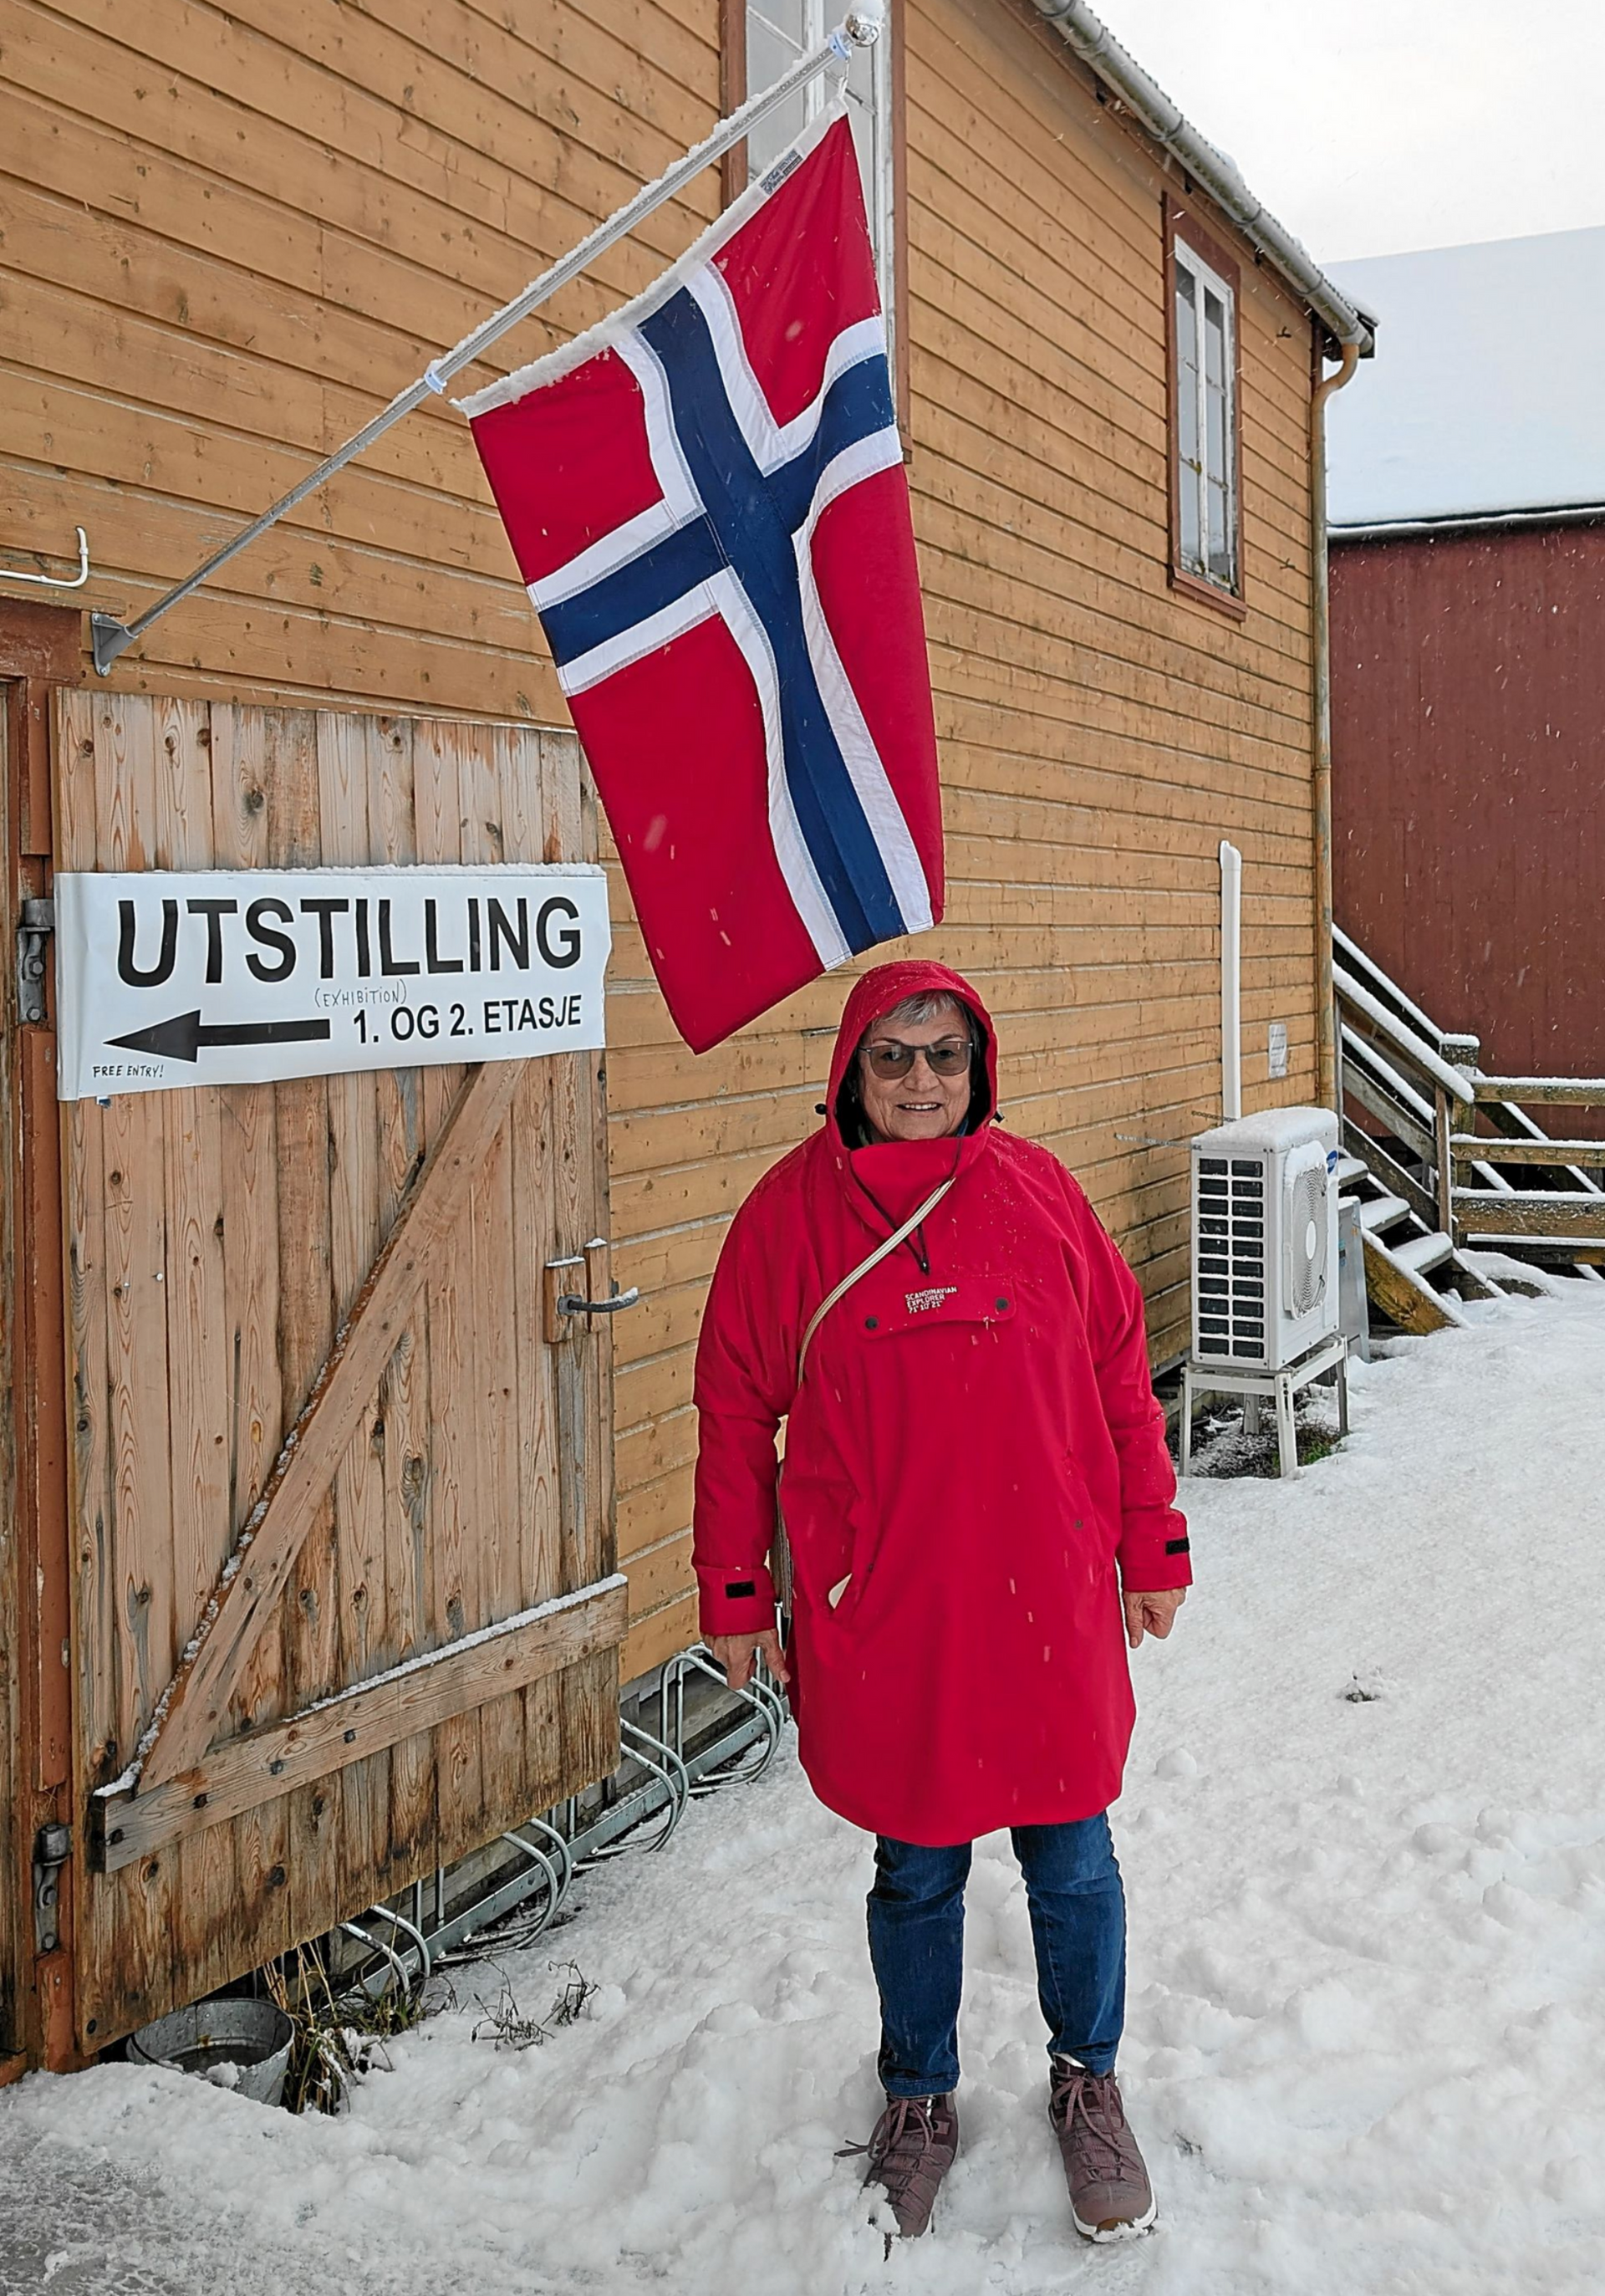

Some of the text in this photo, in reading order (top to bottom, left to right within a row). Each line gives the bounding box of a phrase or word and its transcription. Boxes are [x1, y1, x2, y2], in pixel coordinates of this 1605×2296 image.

[118, 896, 582, 987] UTSTILLING
[314, 978, 407, 1008] (EXHIBITION)
[353, 994, 582, 1043] 1. OG 2. ETASJE
[93, 1064, 164, 1078] FREE ENTRY!
[905, 1287, 957, 1301] SCANDINAVIAN
[907, 1294, 945, 1308] EXPLORER
